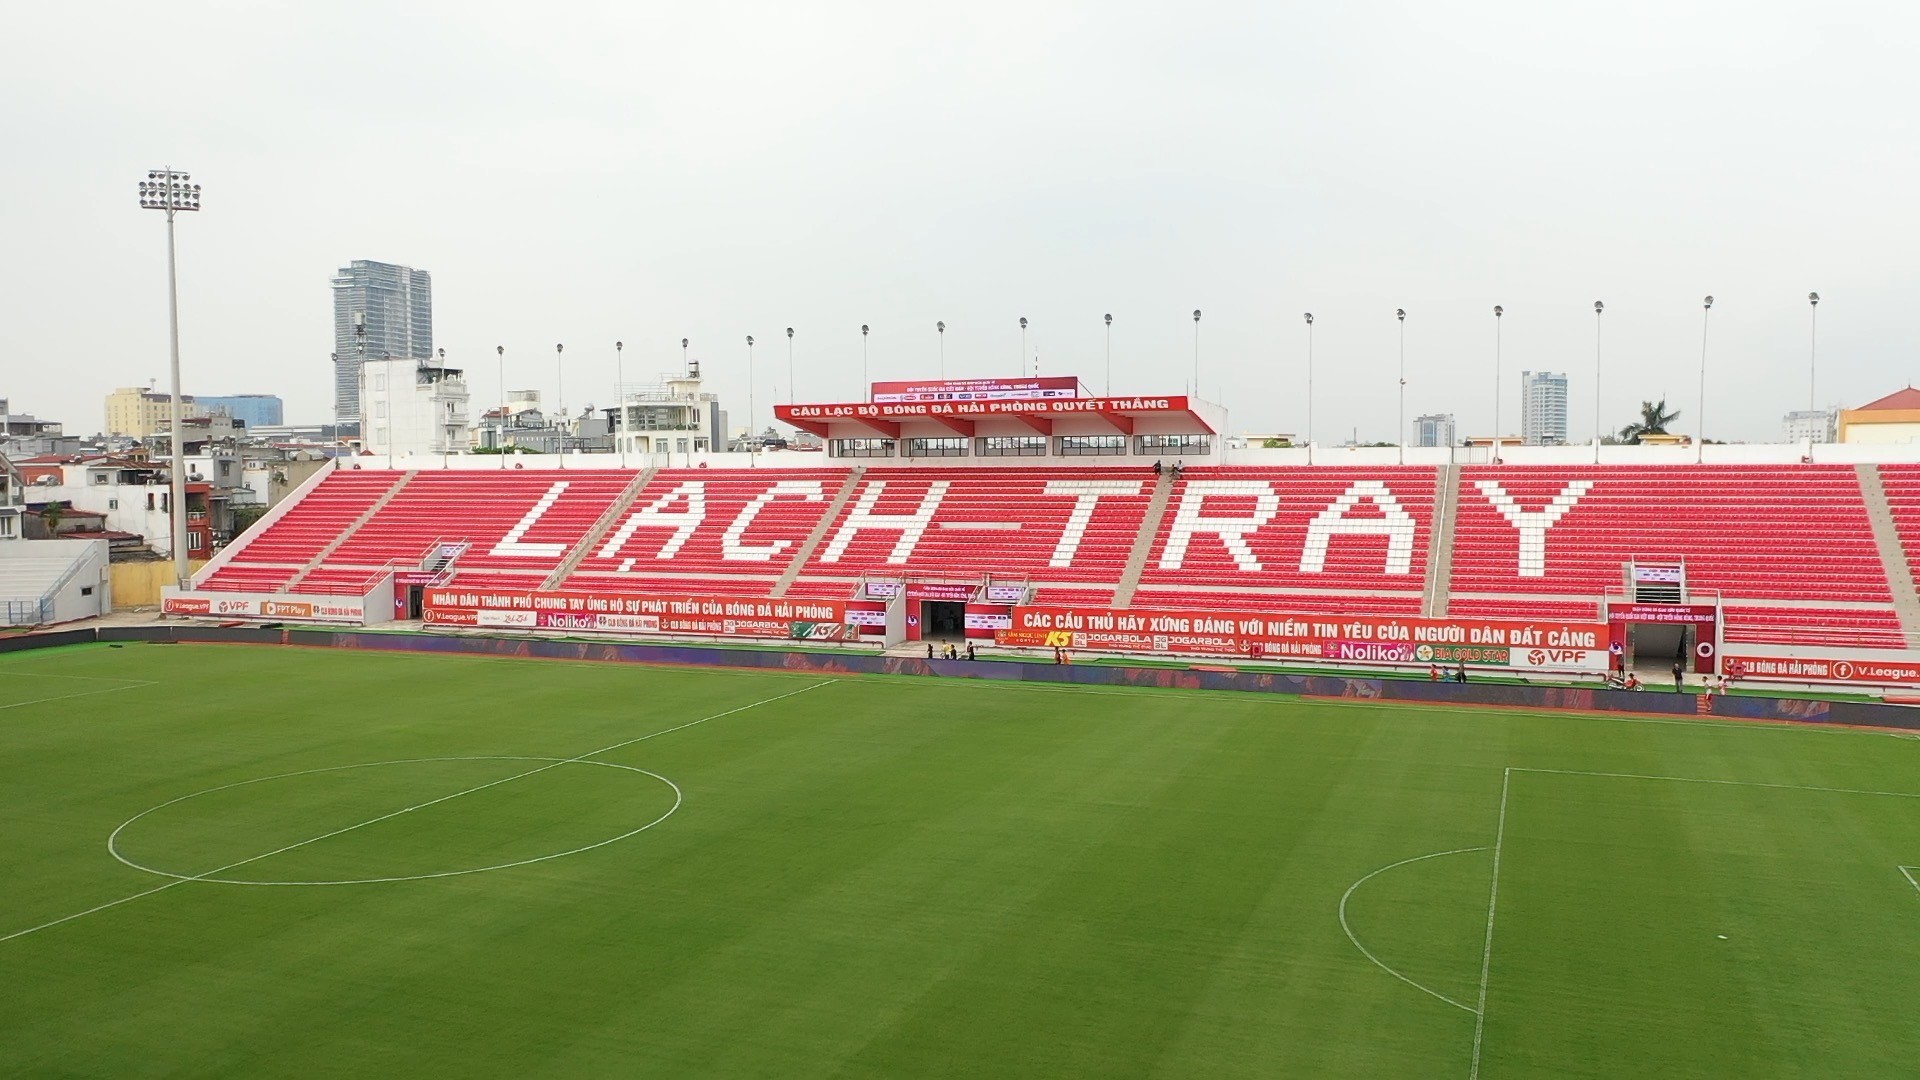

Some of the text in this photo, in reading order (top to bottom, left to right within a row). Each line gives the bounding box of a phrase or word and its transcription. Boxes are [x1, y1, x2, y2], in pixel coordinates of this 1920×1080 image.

[824, 406, 854, 418] LẠC
[858, 406, 878, 416] BỘ
[884, 404, 926, 414] BÓNG
[930, 404, 954, 413] ĐÁ
[958, 402, 985, 412] HẢI
[990, 400, 1048, 412] PHÒNG
[1052, 399, 1105, 411] QUYẾT
[1110, 398, 1169, 410] THẮNG
[230, 601, 249, 610] VPF
[277, 605, 306, 615] FPT Play
[432, 592, 458, 606] NHÂN
[460, 593, 478, 606] DÂN
[481, 594, 511, 608] THÀNH
[513, 594, 532, 608] PHỐ
[535, 598, 567, 610] CHUNG
[569, 598, 584, 610] TAY
[587, 595, 608, 611] ỦNG
[610, 599, 623, 614] HỘ
[626, 599, 640, 615] SỰ
[642, 599, 667, 613] PHÁT
[670, 598, 699, 615] TRIỂN
[702, 600, 723, 616] CỦA
[726, 601, 754, 617] BÓNG
[757, 602, 772, 617] ĐÁ
[775, 602, 792, 618] HẢI
[795, 604, 833, 619] PHÒNG
[548, 615, 586, 628] Noliko
[735, 620, 789, 629] JOGARBOLA
[814, 626, 830, 635] K5
[1024, 612, 1052, 628] CÁC
[1055, 611, 1082, 629] CẦU
[1086, 612, 1114, 630] THỦ
[1118, 614, 1146, 630] HÃY
[1150, 615, 1189, 633] XỨNG
[1193, 616, 1235, 634] ĐÁNG
[1239, 618, 1264, 635] VỚI
[1268, 618, 1308, 636] NIỀM
[1313, 624, 1338, 638] TIN
[1343, 621, 1372, 639] YÊU
[1377, 621, 1410, 640] CỦA
[1414, 624, 1465, 643] NGƯỜI
[1470, 625, 1505, 644] DÂN
[1510, 624, 1543, 646] ĐẤT
[1548, 626, 1595, 647] CẢNG
[1045, 631, 1072, 646] K5
[1087, 634, 1151, 642] JOGARBOLA
[1168, 636, 1234, 645] JOGARBOLA
[1341, 643, 1398, 661] Noliko
[1435, 648, 1508, 663] BIA GOLD STAR
[1547, 650, 1586, 663] VPF
[1803, 662, 1828, 676] PHÒNG
